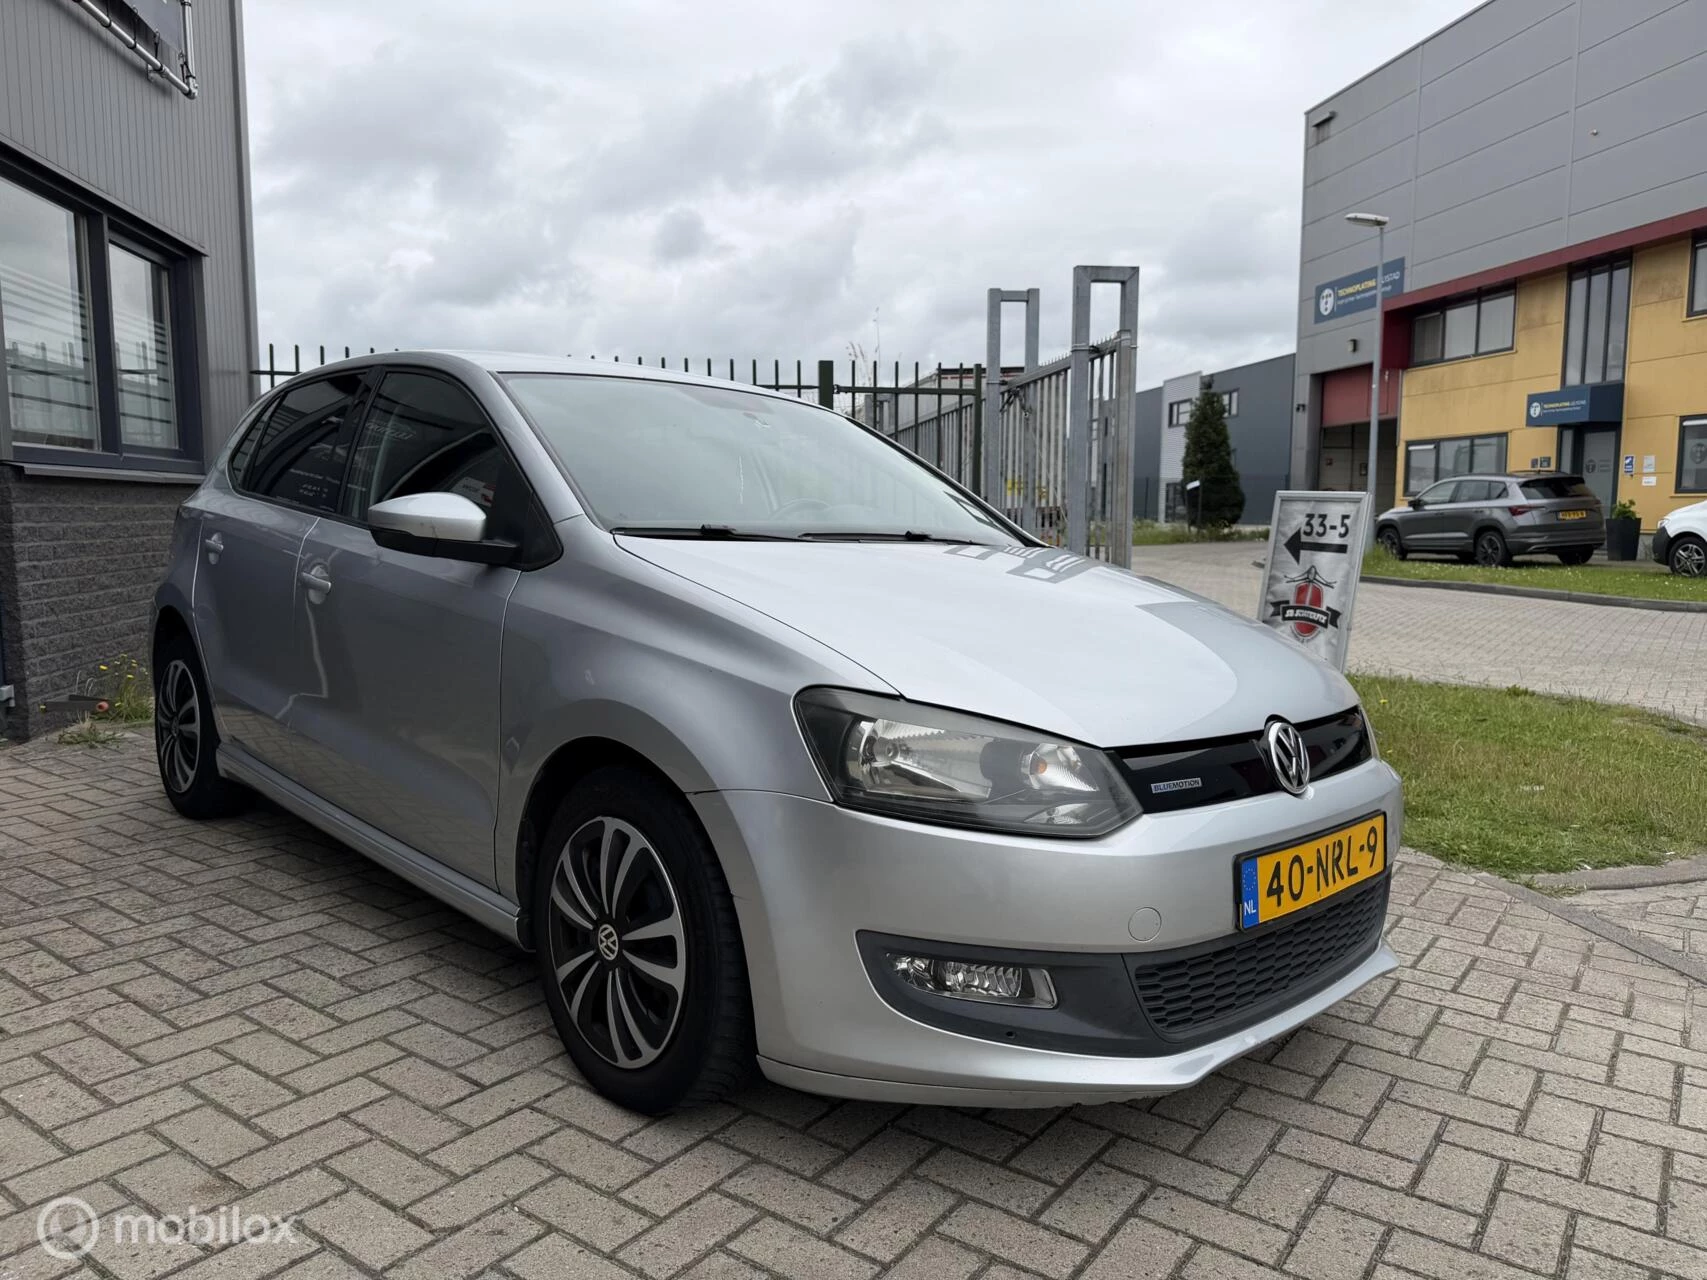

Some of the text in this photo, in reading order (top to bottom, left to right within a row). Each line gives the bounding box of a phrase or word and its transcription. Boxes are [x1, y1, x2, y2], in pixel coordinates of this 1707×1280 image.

[1303, 513, 1350, 538] 33-5
[1153, 779, 1200, 792] BLUEMOTION
[1266, 826, 1378, 907] 40-NRL-9
[1244, 901, 1257, 916] NL
